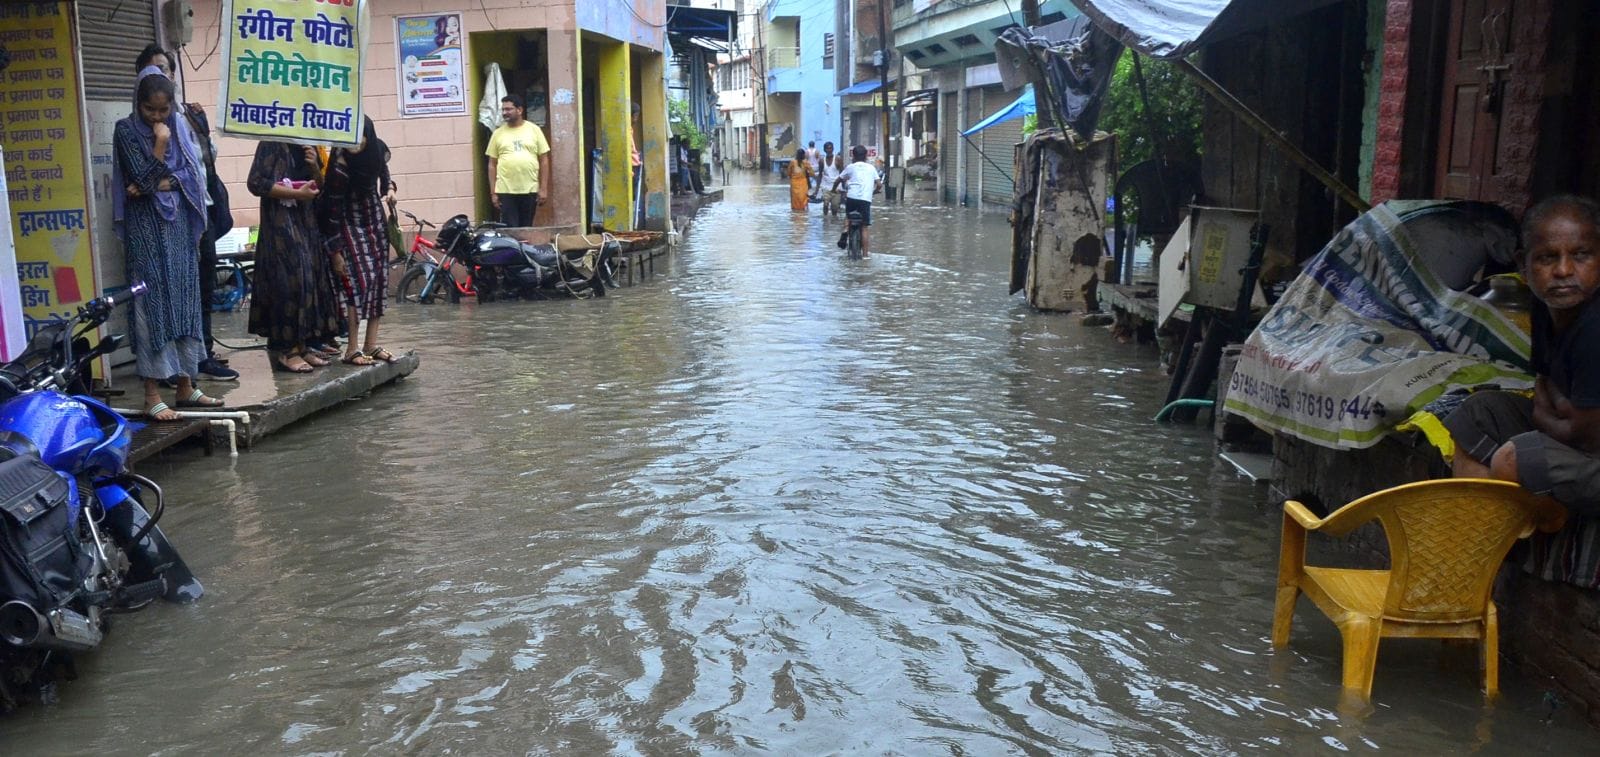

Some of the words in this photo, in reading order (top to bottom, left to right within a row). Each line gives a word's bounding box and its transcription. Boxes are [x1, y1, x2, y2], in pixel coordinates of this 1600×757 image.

[236, 8, 295, 42] रंगीन
[302, 13, 354, 49] फोटो
[9, 69, 42, 84] प्रमाण
[46, 68, 64, 80] पत्र
[236, 49, 352, 93] लेमिनेशन
[9, 89, 43, 104] प्रमाण
[47, 88, 65, 100] पत्र
[7, 110, 39, 125] प्रमाण
[44, 108, 62, 120] पत्र
[230, 98, 296, 129] मोबाईल
[302, 103, 352, 133] रिचार्ज
[11, 129, 43, 144] प्रमाण
[47, 128, 65, 140] पत्र
[28, 144, 54, 161] कार्ड
[18, 209, 85, 237] ट्रान्सफर
[20, 285, 50, 307] डिंग
